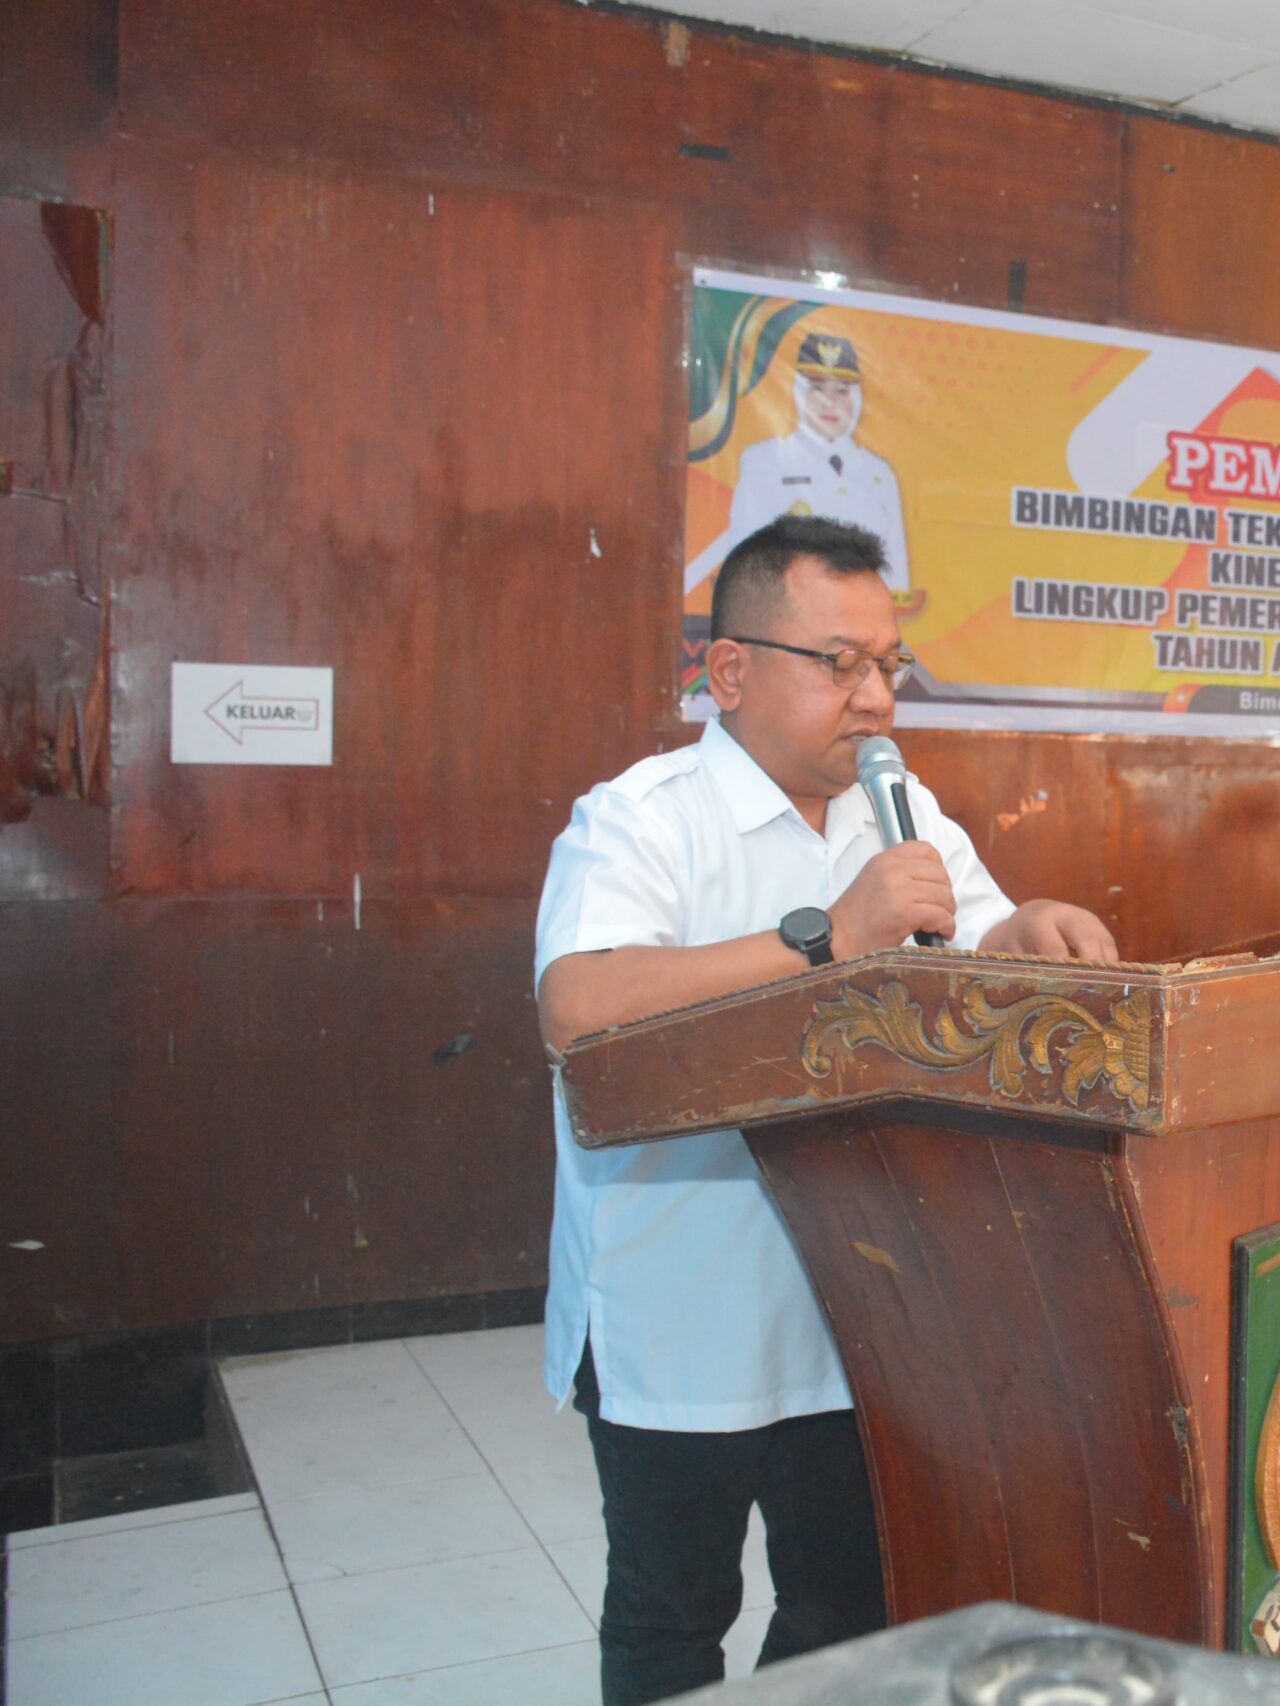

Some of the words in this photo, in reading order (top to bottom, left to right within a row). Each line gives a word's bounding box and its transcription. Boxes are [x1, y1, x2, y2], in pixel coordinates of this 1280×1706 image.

[1014, 489, 1216, 541] BIMBINGAN
[1014, 579, 1167, 622] LINGKUP
[1153, 634, 1261, 672] TAHUN
[226, 704, 297, 721] KELUAR
